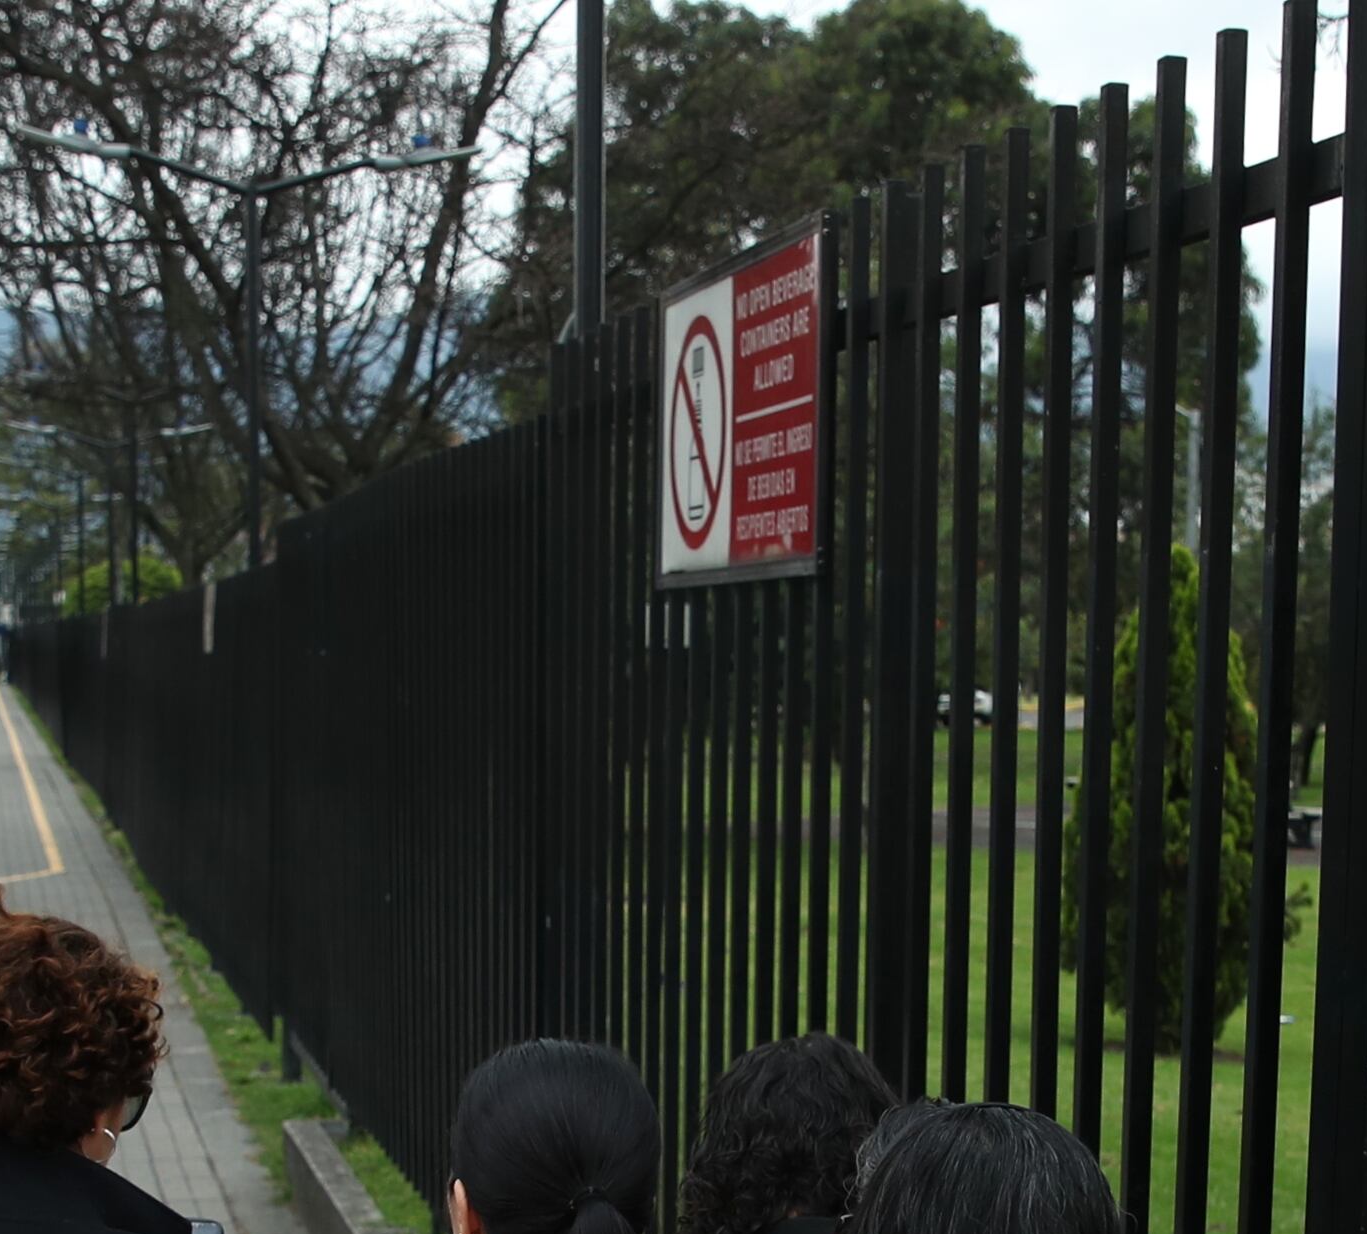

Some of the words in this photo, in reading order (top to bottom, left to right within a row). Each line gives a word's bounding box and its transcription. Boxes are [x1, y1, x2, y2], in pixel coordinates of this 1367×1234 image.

[736, 292, 748, 321] NO
[749, 283, 770, 316] OPEN
[740, 313, 791, 358] CONTAINERS
[792, 305, 810, 338] ARE
[753, 353, 794, 391] ALLOWED
